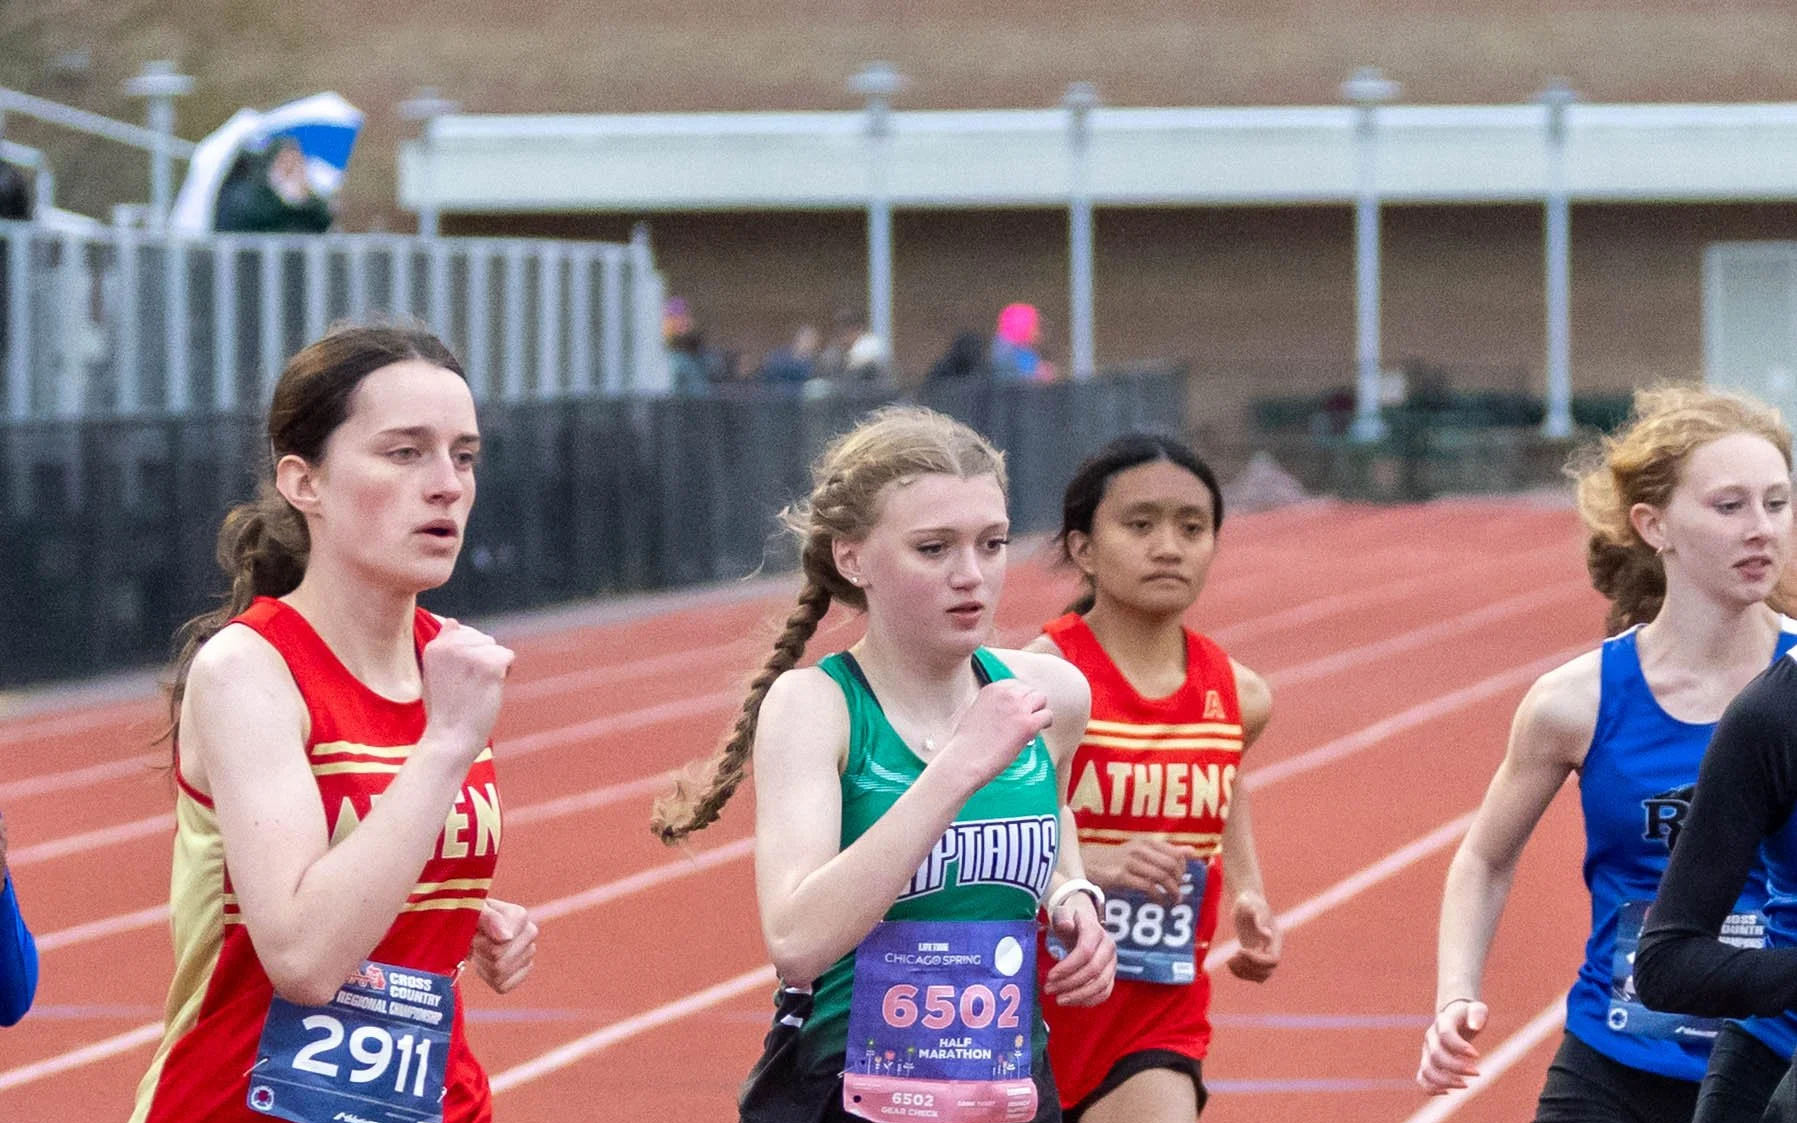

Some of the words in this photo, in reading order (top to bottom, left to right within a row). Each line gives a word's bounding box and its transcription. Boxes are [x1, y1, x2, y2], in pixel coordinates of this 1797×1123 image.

[1203, 690, 1225, 719] A
[1070, 760, 1237, 819] ATHENS
[329, 783, 501, 859] AEN
[898, 816, 1057, 901] PTAINS
[1104, 898, 1194, 948] 883
[884, 952, 941, 965] CHICAGO
[942, 954, 981, 966] SPRING
[389, 972, 432, 991] CROSS
[336, 990, 388, 1014] REGIONAL
[389, 985, 442, 1007] COUNTRY
[882, 983, 1021, 1029] 6502
[918, 1049, 992, 1060] MARATHON
[939, 1037, 972, 1048] HALF
[291, 1014, 432, 1097] 2911
[892, 1092, 934, 1107] 6502
[881, 1107, 906, 1116] GEAR
[908, 1108, 938, 1118] CHECK
